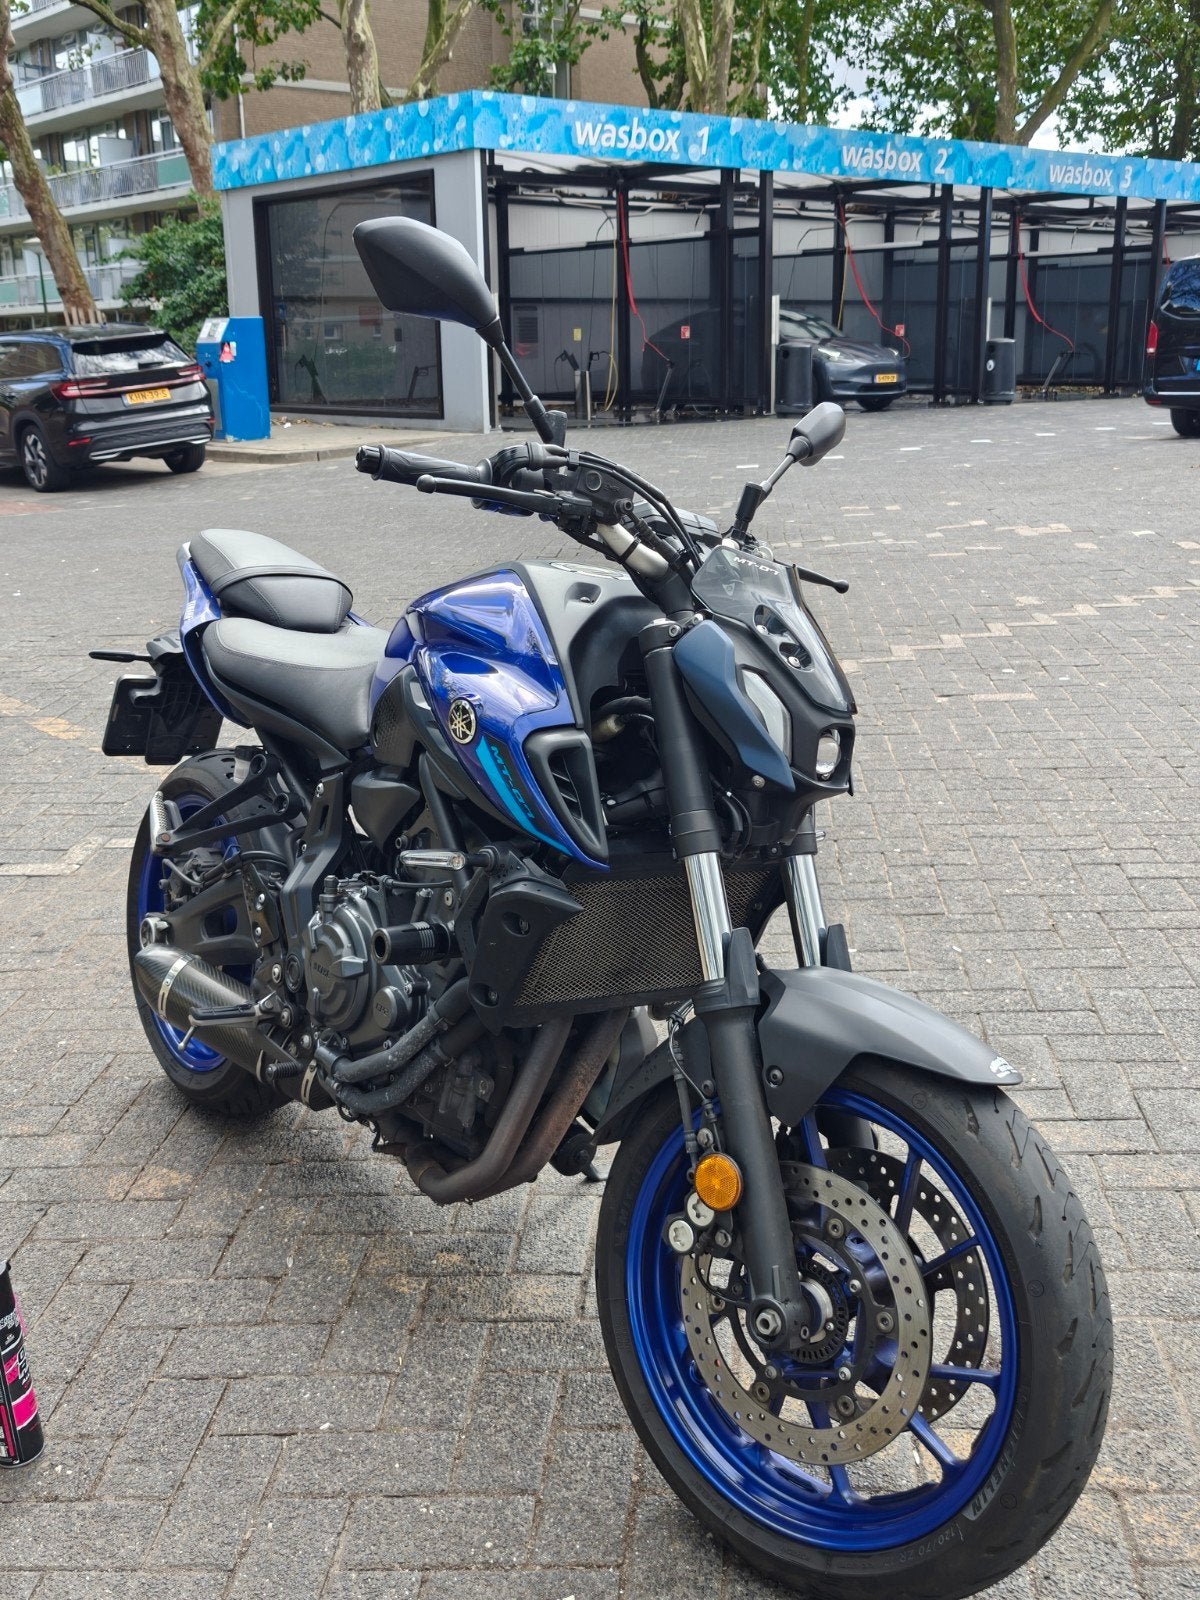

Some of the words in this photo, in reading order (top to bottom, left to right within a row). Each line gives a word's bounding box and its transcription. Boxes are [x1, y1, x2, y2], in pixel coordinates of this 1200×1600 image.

[575, 117, 680, 153] wasbox
[696, 126, 709, 155] 1
[842, 141, 922, 172] wasbox
[934, 148, 947, 174] 2
[1049, 160, 1113, 187] wasbox
[1121, 165, 1132, 189] 3
[734, 557, 780, 575] MT-07
[490, 745, 535, 819] MT-07
